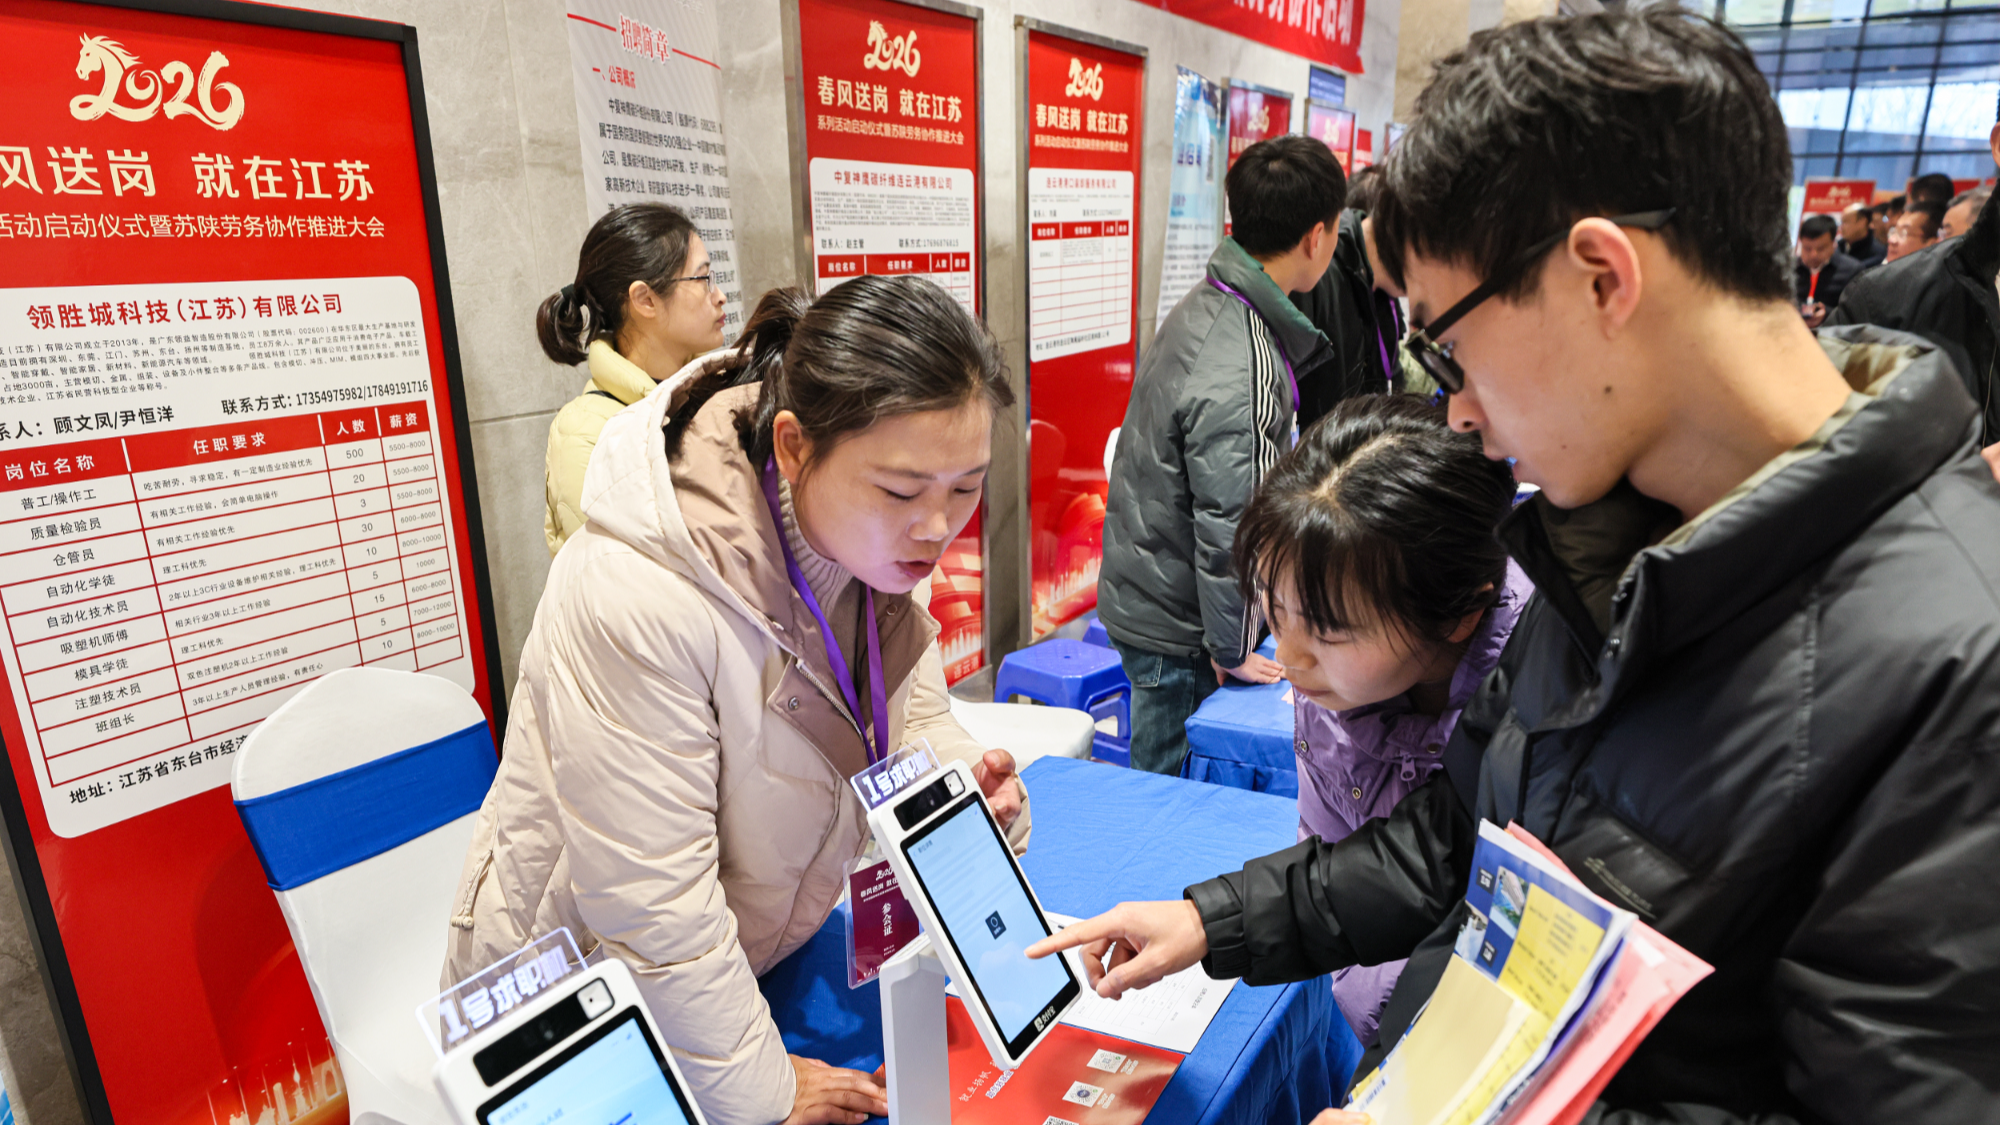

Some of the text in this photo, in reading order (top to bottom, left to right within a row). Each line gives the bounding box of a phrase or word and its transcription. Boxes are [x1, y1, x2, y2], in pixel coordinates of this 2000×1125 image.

[620, 14, 669, 62] 招聘简章
[864, 19, 921, 78] 2026
[69, 32, 245, 131] 2026
[818, 75, 962, 123] 春风送岗 就在江苏
[1036, 103, 1128, 135] 春风送岗 就在江苏
[191, 152, 375, 201] 就在江苏
[26, 293, 342, 330] 领胜城科技（江苏）有限公司
[4, 412, 418, 481] 岗位名称 任职要求 人数 薪资
[21, 488, 97, 511] 普工/操作工
[346, 448, 364, 460] 500
[30, 517, 102, 541] 质量检验员
[352, 473, 366, 484] 20
[53, 548, 95, 567] 仓管员
[156, 525, 236, 548] 有相关工作经验优先
[360, 498, 367, 508] 3
[46, 574, 116, 599] 自动化学徒
[162, 558, 207, 575] 理工科优先
[361, 522, 374, 533] 30
[46, 600, 129, 629] 自动化技术员
[366, 546, 377, 556] 10
[60, 558, 436, 655] 吸塑机师傅 相关行业3年以上工作经验 5 10000
[74, 658, 129, 682] 模具学徒
[181, 637, 224, 655] 理工科优先
[374, 594, 385, 603] 15
[75, 682, 142, 710] 注塑技术员
[187, 646, 288, 681] 双色注塑机2年以上工作经验
[380, 618, 387, 627] 5
[95, 713, 135, 733] 班组长
[382, 639, 393, 650] 10
